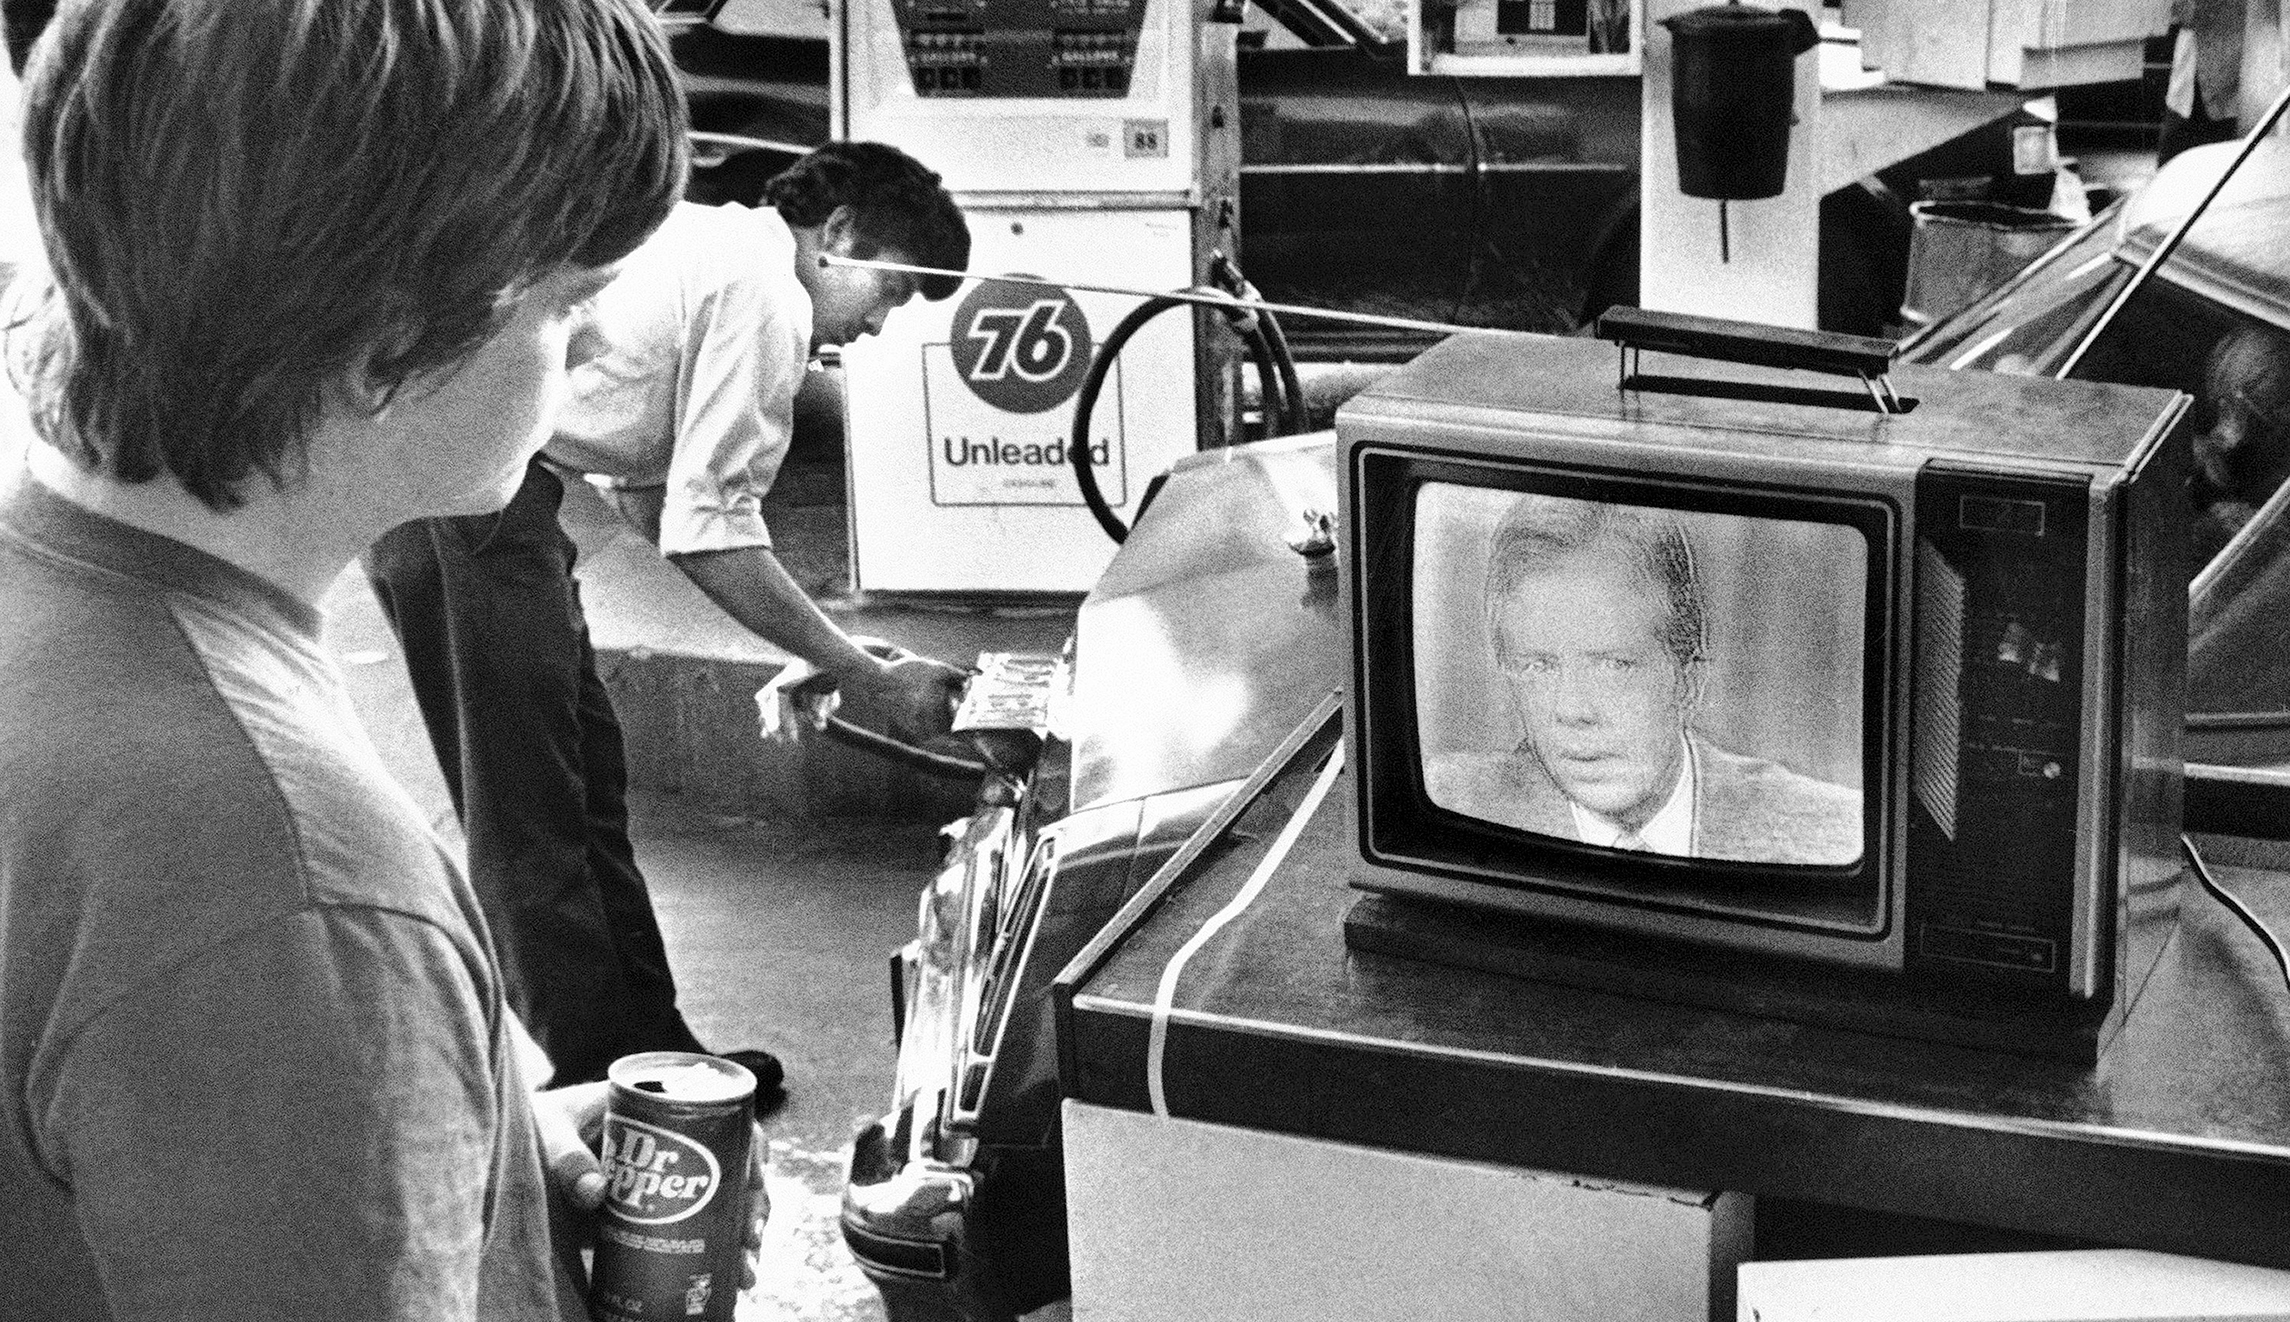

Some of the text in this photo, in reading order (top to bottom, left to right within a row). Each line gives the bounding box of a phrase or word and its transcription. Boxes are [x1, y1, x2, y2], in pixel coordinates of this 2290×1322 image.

[968, 299, 1072, 382] 76
[944, 436, 1110, 467] Unleadd
[615, 1126, 680, 1173] Dr
